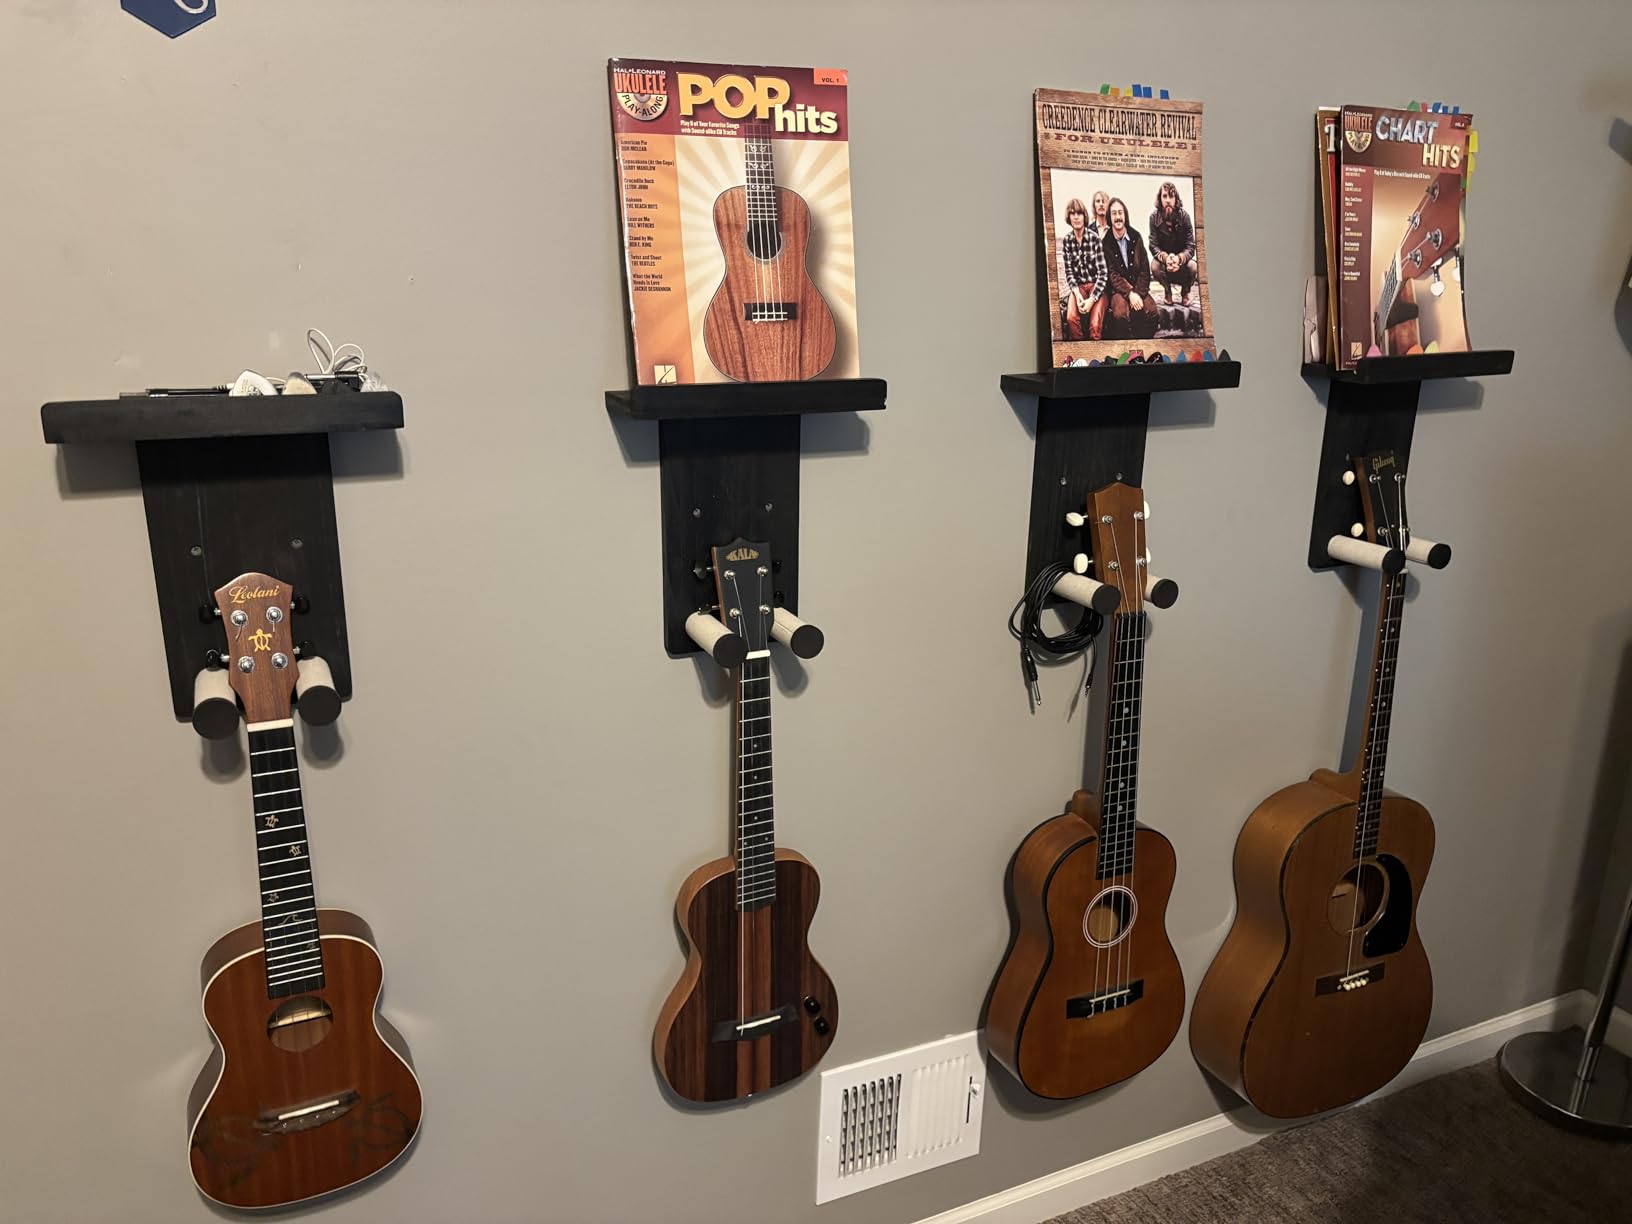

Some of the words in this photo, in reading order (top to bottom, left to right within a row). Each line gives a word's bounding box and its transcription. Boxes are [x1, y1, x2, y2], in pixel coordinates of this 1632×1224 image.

[613, 73, 667, 95] UKULELE
[676, 72, 791, 119] POP
[621, 94, 664, 117] PLAY-ALONG
[774, 103, 839, 134] hits
[1042, 103, 1096, 133] CREEDENCE
[1098, 108, 1158, 138] CLEARWATER
[1160, 113, 1197, 141] REVIVAL
[1345, 115, 1373, 131] UKULELE
[1375, 115, 1439, 145] CHART
[1054, 132, 1095, 144] FOR
[1099, 136, 1188, 150] UKULELE
[1422, 143, 1461, 169] HITS
[1372, 455, 1396, 475] Gibson
[229, 585, 280, 604] Leolani
